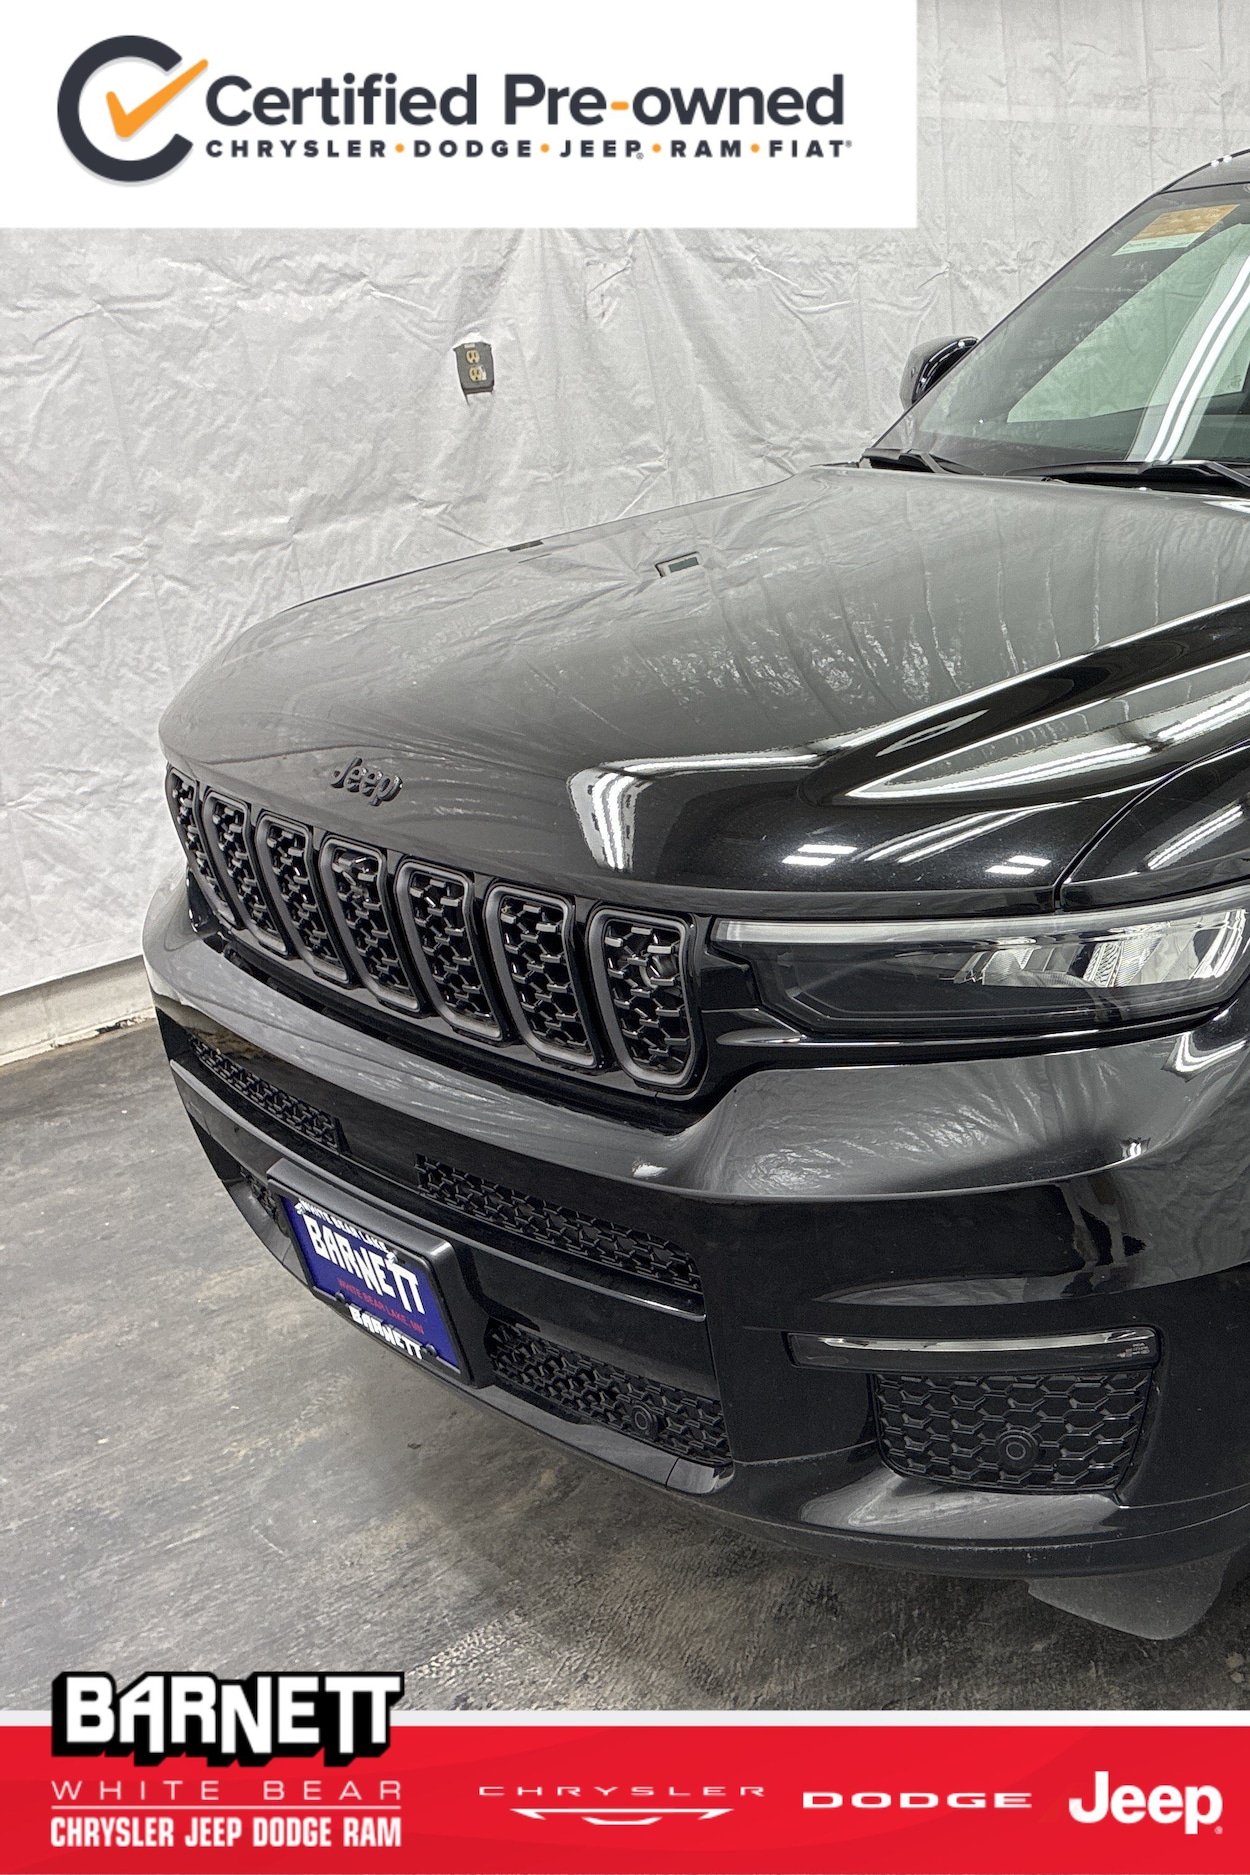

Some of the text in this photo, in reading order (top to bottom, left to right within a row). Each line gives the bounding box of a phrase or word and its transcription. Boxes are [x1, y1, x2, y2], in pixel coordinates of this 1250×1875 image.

[330, 757, 403, 807] Jeep
[303, 1213, 425, 1315] BARNETT
[347, 1302, 424, 1360] BARNETT
